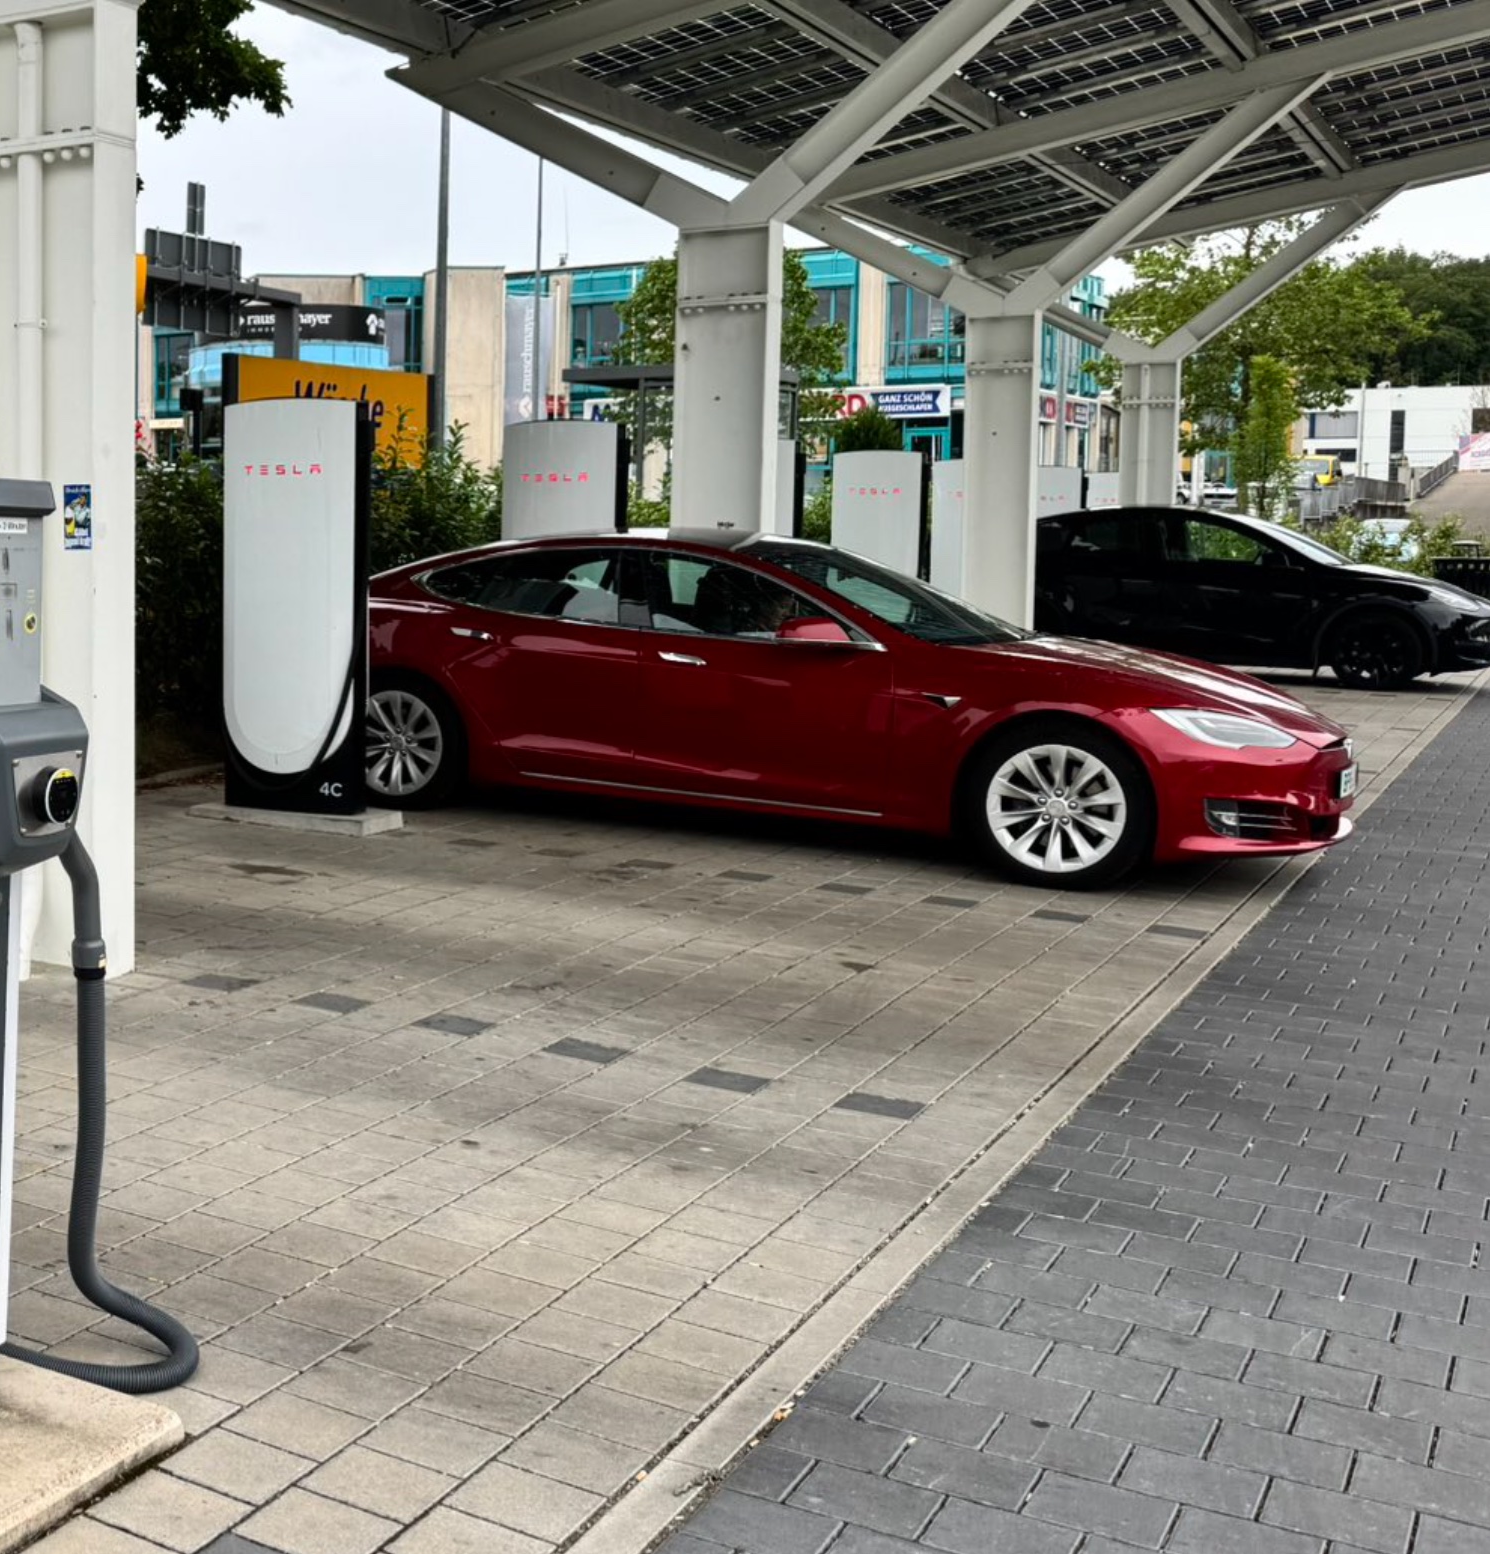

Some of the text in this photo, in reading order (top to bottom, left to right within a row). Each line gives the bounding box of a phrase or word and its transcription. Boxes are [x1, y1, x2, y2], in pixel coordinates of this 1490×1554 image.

[247, 313, 332, 327] rausayer
[878, 391, 933, 404] GANZ SCHÖN
[244, 464, 321, 476] TESLA
[319, 782, 343, 797] 4C
